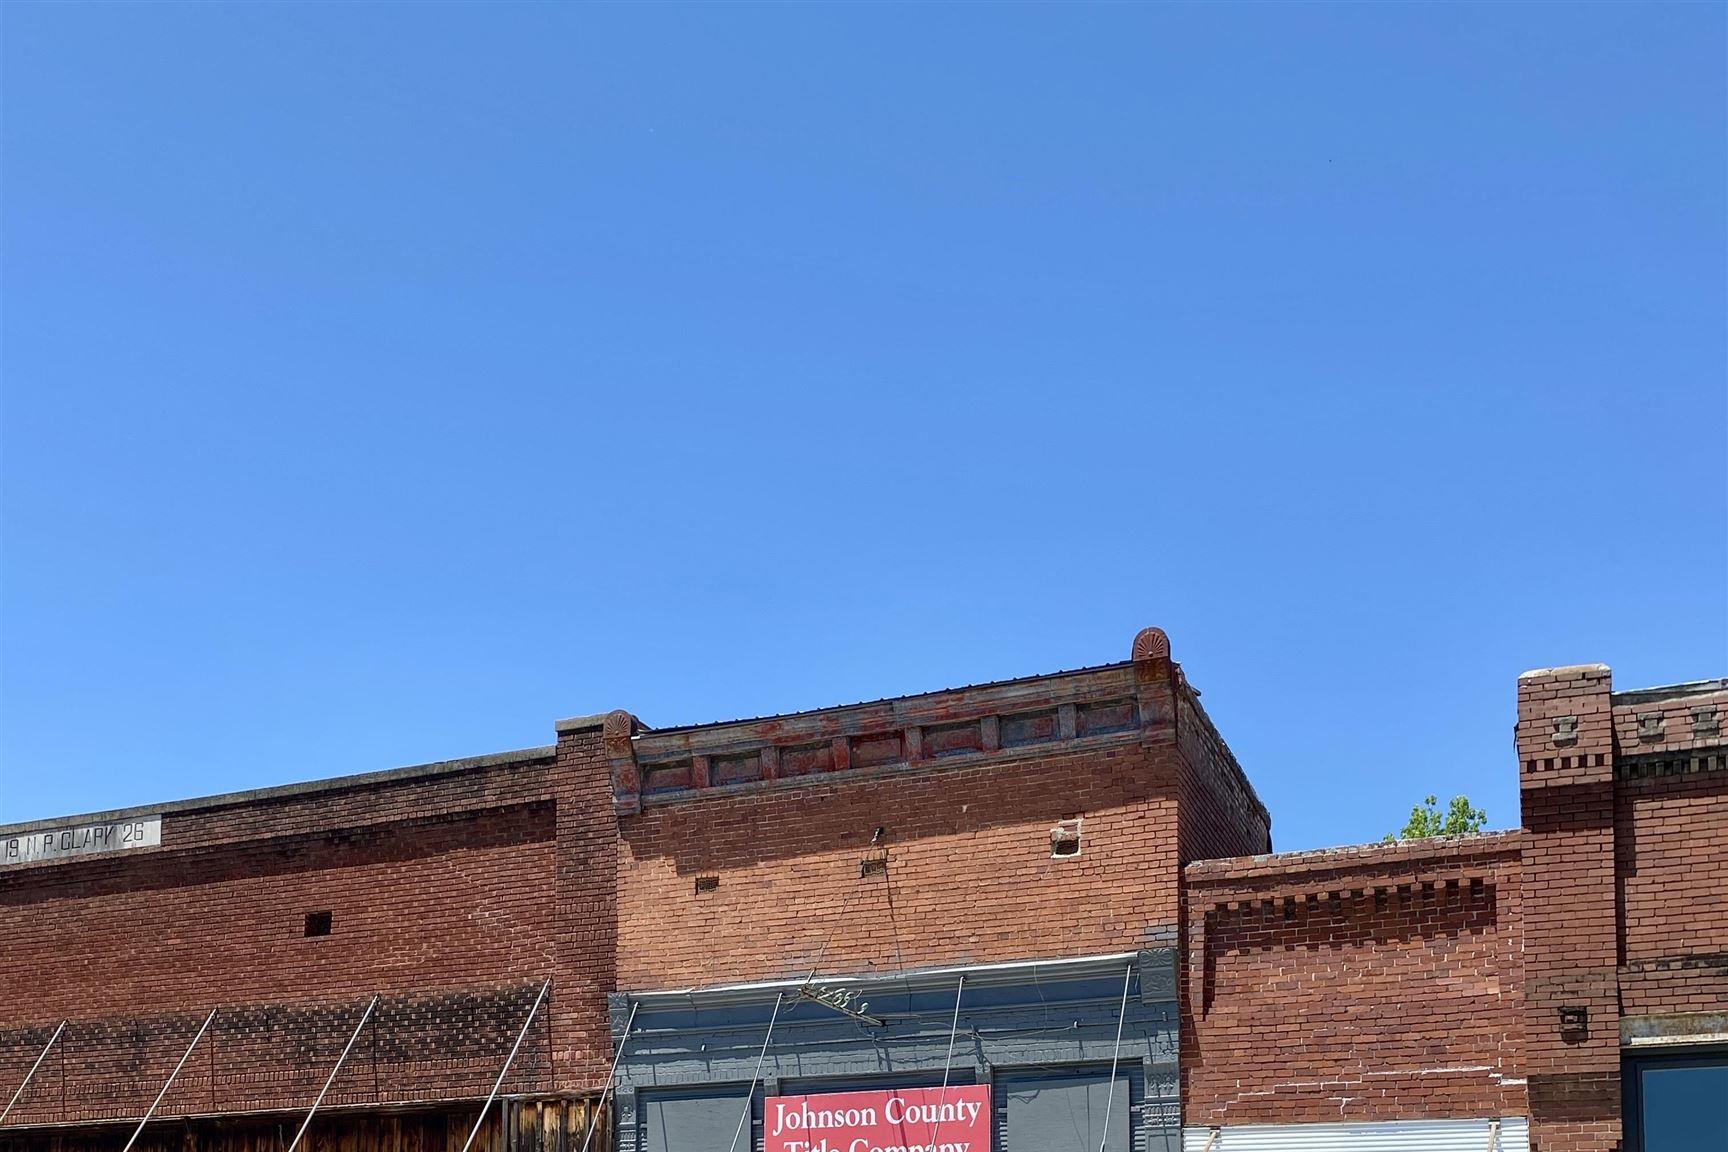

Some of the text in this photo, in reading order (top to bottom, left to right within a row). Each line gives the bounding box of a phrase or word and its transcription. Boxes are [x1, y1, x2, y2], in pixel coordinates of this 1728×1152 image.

[6, 839, 19, 858] 19
[123, 823, 144, 842] 26
[772, 1097, 982, 1137] Johnson County
